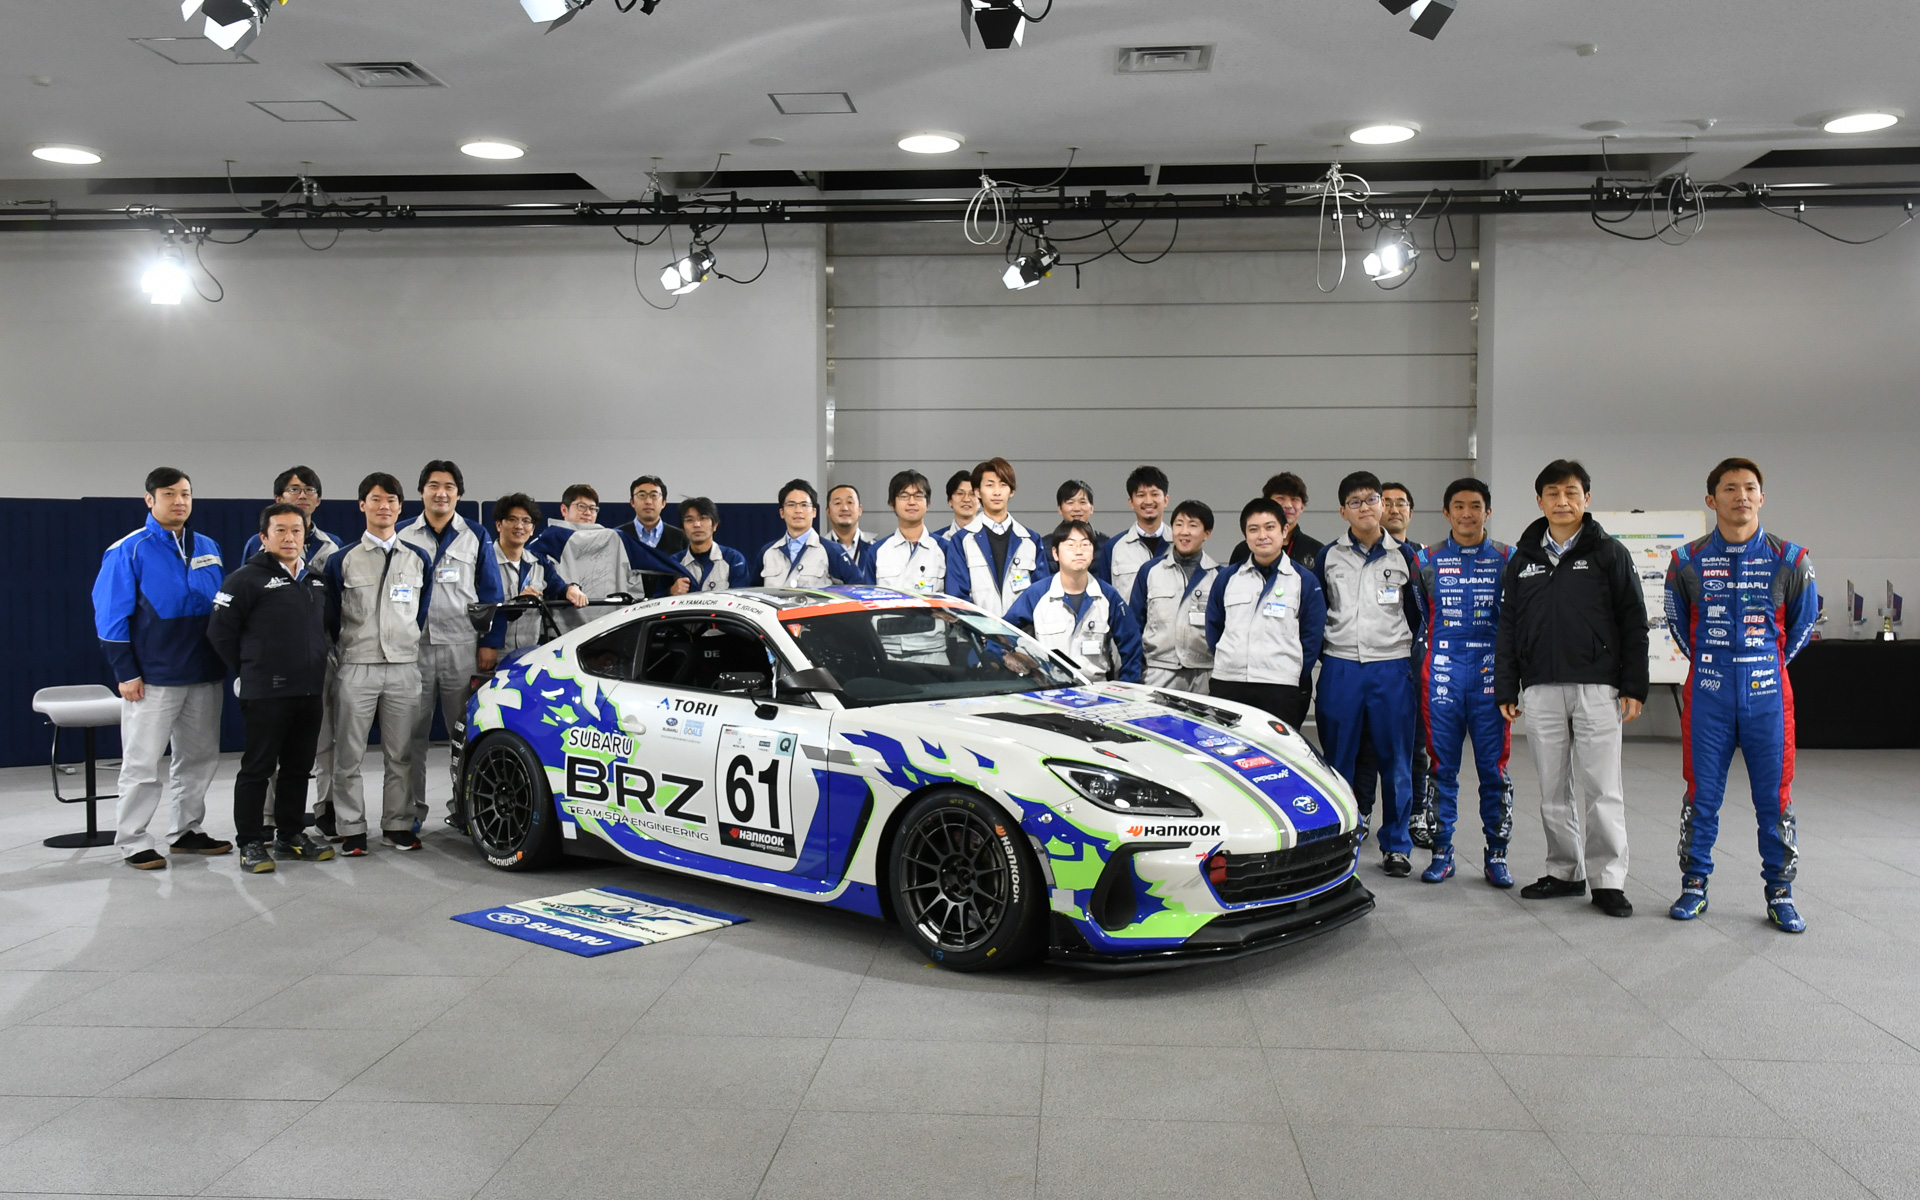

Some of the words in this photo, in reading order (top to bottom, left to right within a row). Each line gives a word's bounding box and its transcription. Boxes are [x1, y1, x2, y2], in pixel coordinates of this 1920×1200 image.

[1703, 569, 1729, 577] MOTUL
[1726, 581, 1768, 590] SUBARU
[1745, 638, 1765, 647] SPK
[674, 698, 719, 717] TORII
[568, 728, 633, 756] SUBARU
[779, 737, 792, 753] Q
[566, 755, 707, 825] BRZ
[725, 753, 780, 830] 61
[567, 805, 602, 818] TEAM
[604, 811, 629, 823] SDA
[630, 817, 710, 842] ENGINEERING
[523, 921, 613, 947] SUBARU
